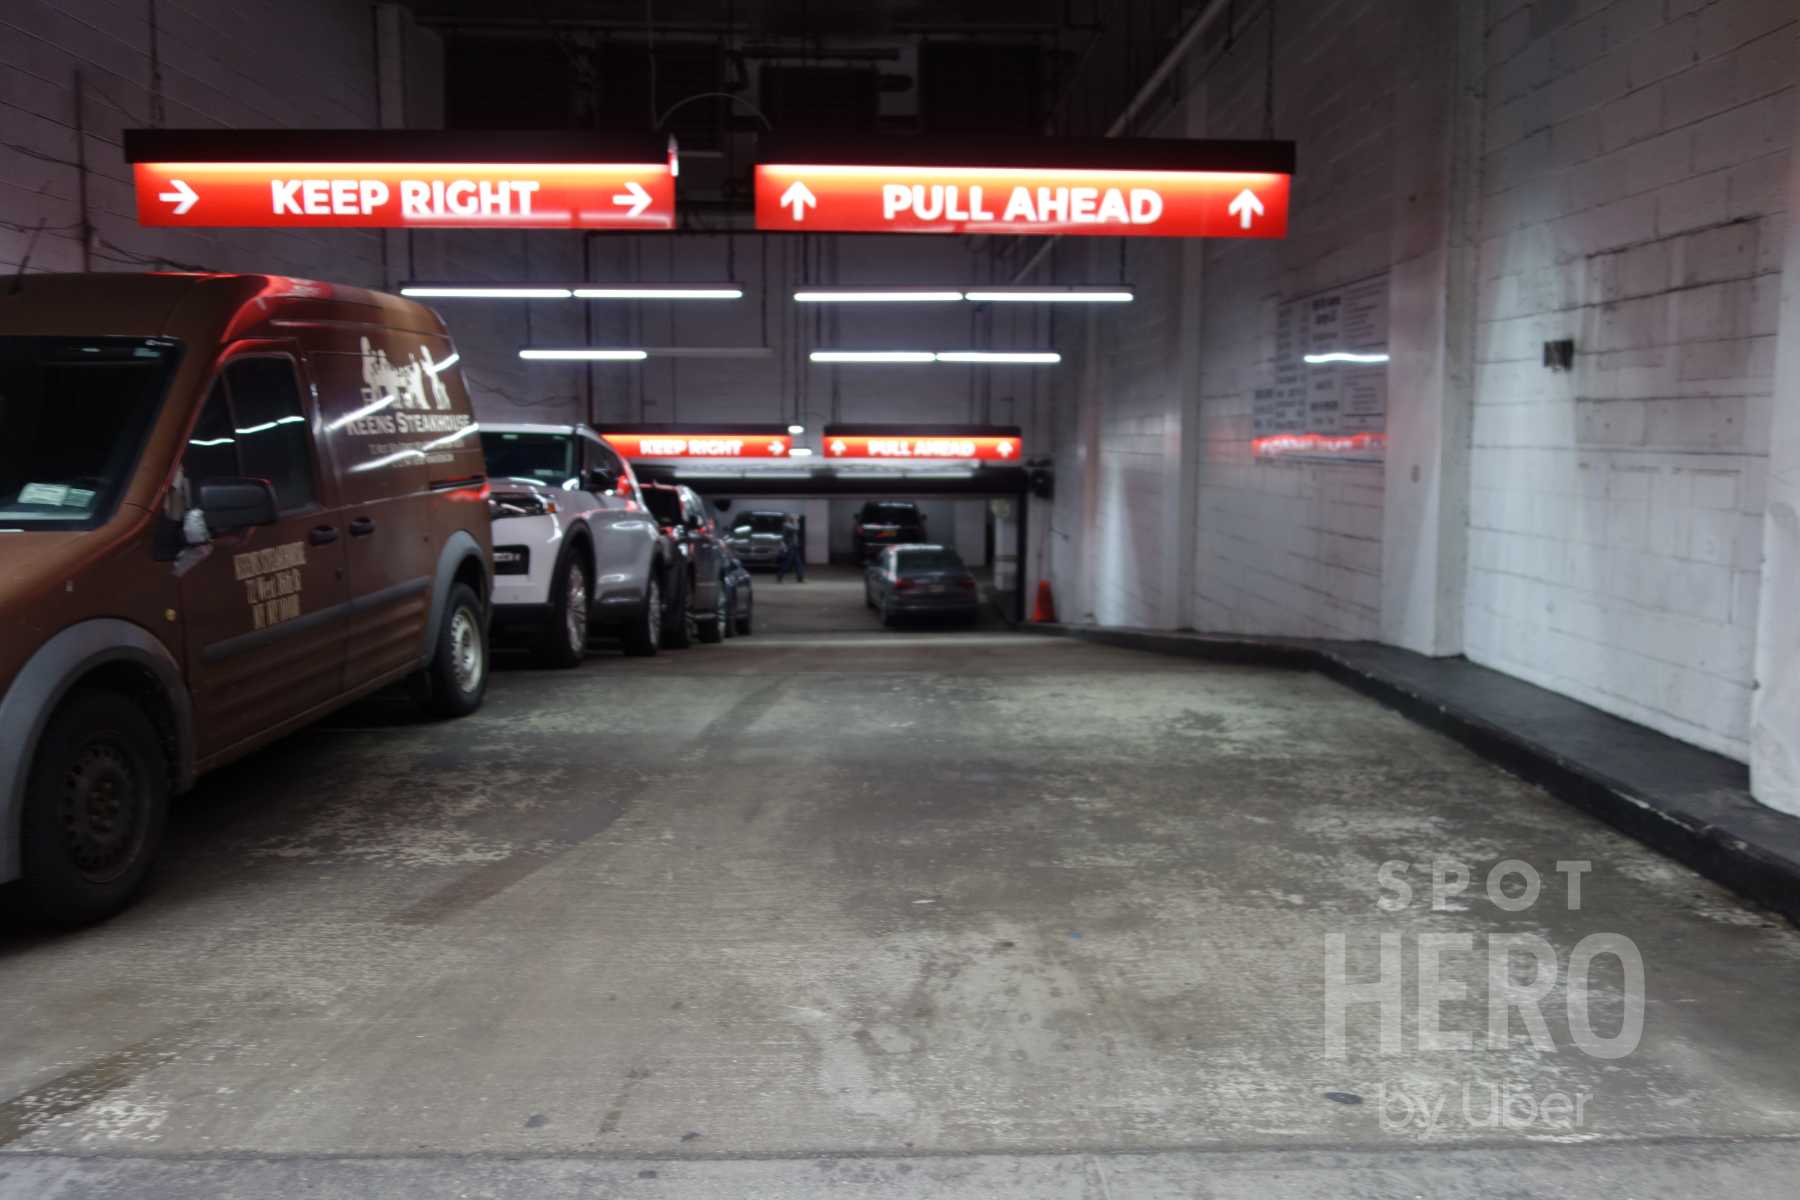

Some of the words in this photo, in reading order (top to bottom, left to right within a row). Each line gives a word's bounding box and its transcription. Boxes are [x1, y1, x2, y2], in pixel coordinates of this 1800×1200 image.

[271, 180, 390, 216] KEEP
[401, 181, 540, 217] RIGHT
[882, 183, 994, 221] PULL
[1003, 186, 1163, 225] AHEAD
[346, 415, 396, 436] KEENS
[640, 439, 688, 455] KEEP
[688, 439, 743, 455] RIGHT
[867, 440, 911, 456] PULL
[912, 440, 976, 457] AHEAD
